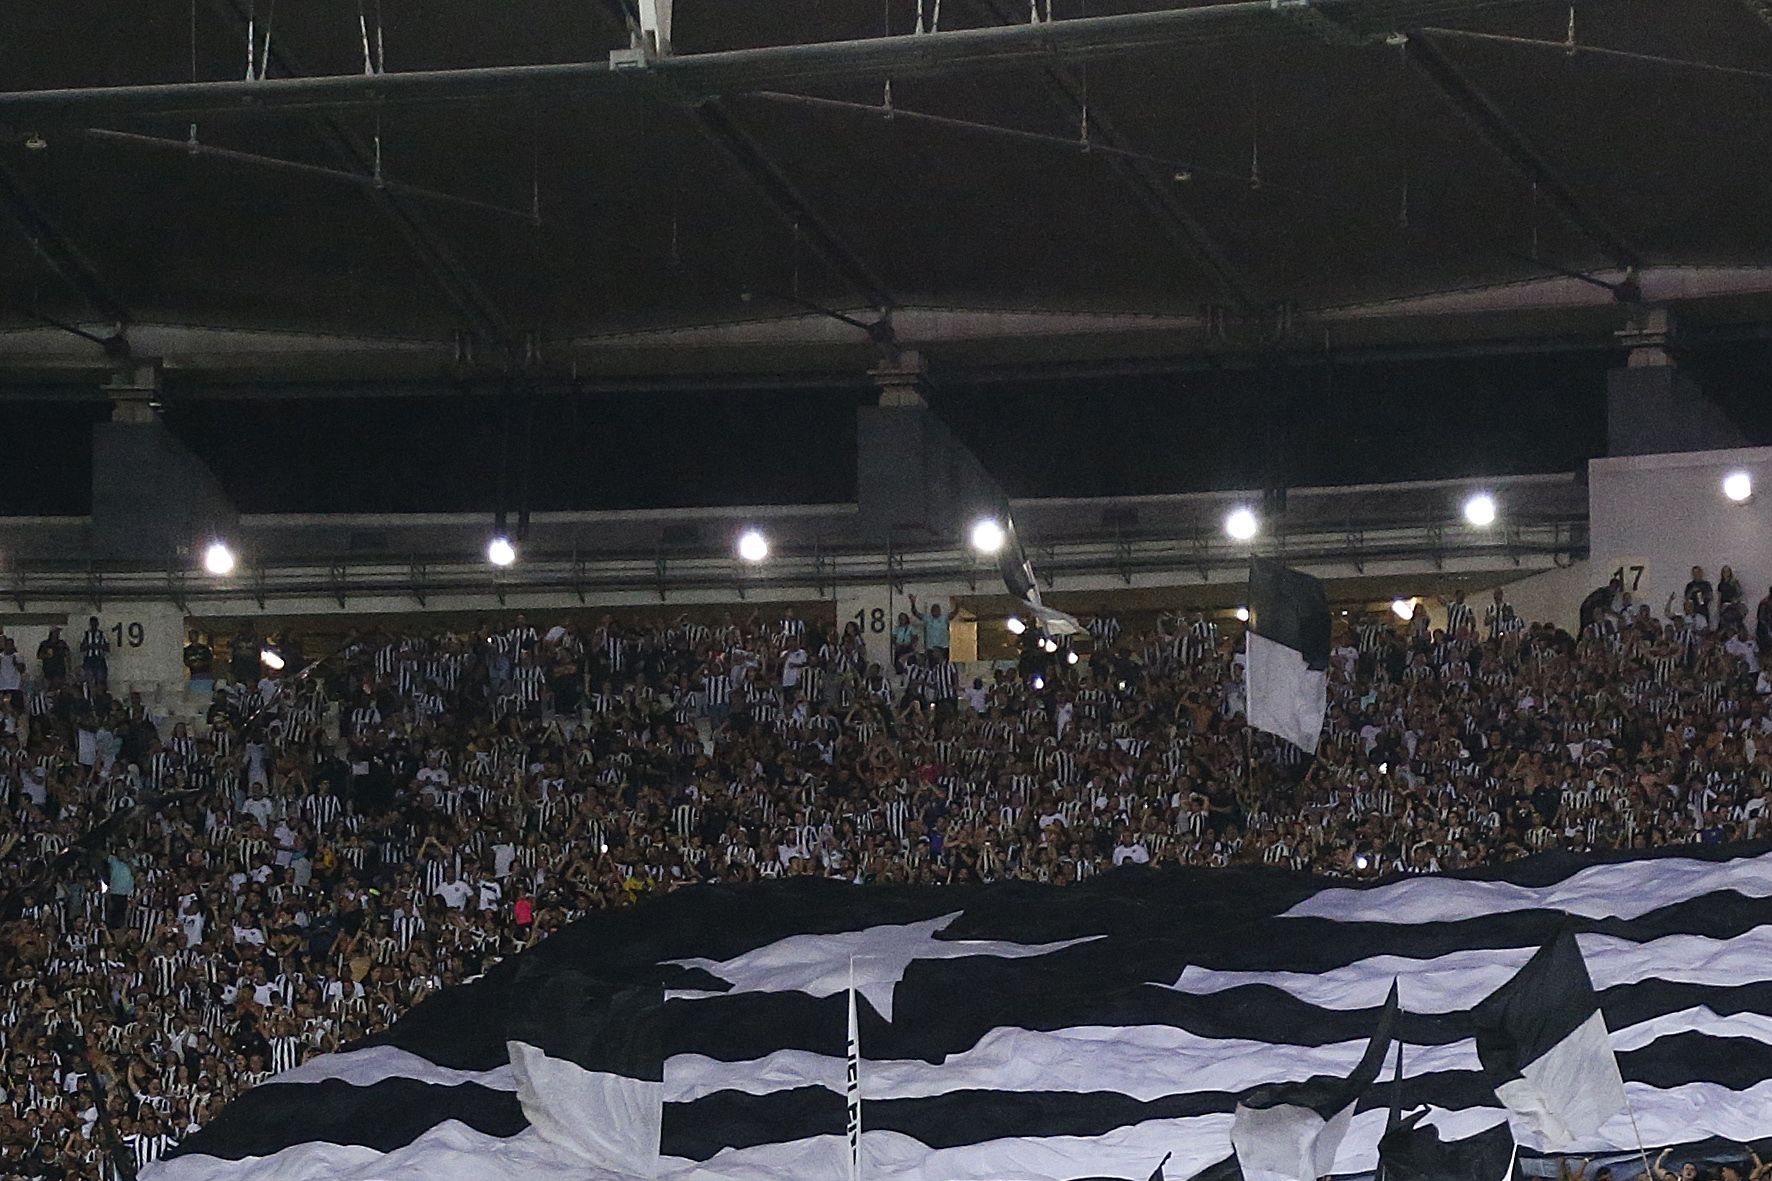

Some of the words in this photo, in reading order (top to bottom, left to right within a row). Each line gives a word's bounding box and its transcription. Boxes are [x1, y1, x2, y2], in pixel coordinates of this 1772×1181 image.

[1612, 565, 1645, 592] 17
[855, 606, 886, 633] 18
[111, 621, 145, 648] 19
